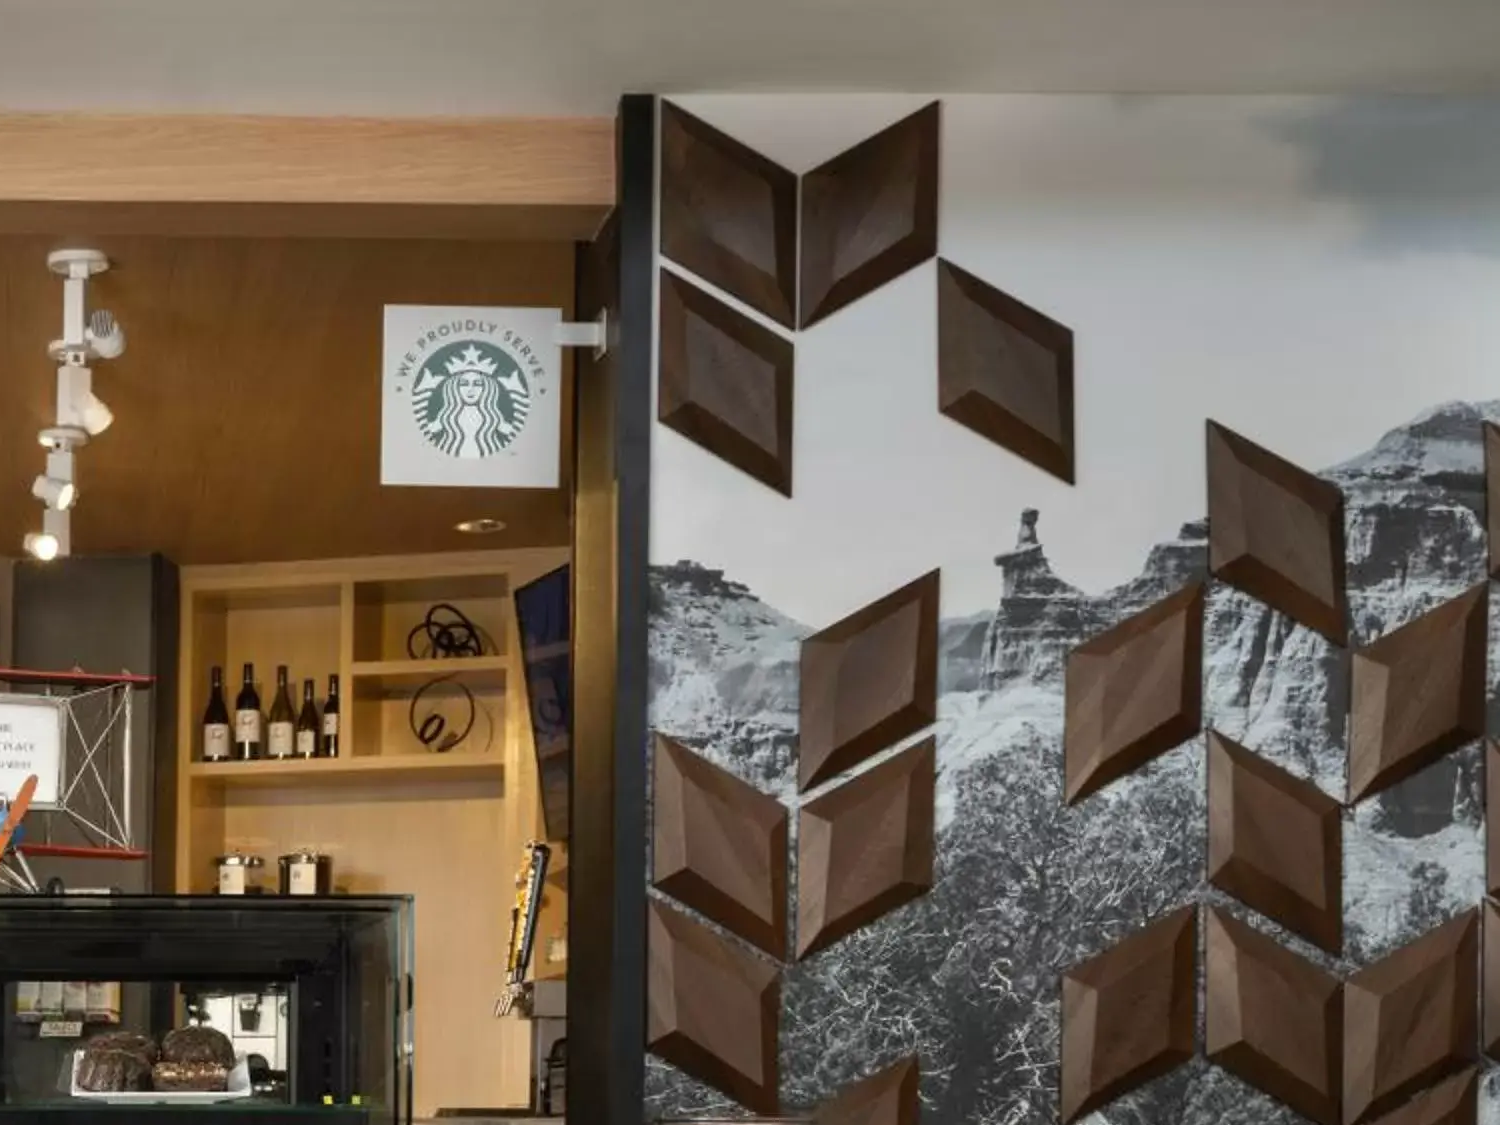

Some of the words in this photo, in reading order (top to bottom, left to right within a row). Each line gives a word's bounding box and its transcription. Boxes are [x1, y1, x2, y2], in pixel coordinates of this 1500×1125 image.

[398, 351, 417, 378] WE
[416, 318, 498, 350] PROUDLY
[502, 329, 546, 378] SERVE
